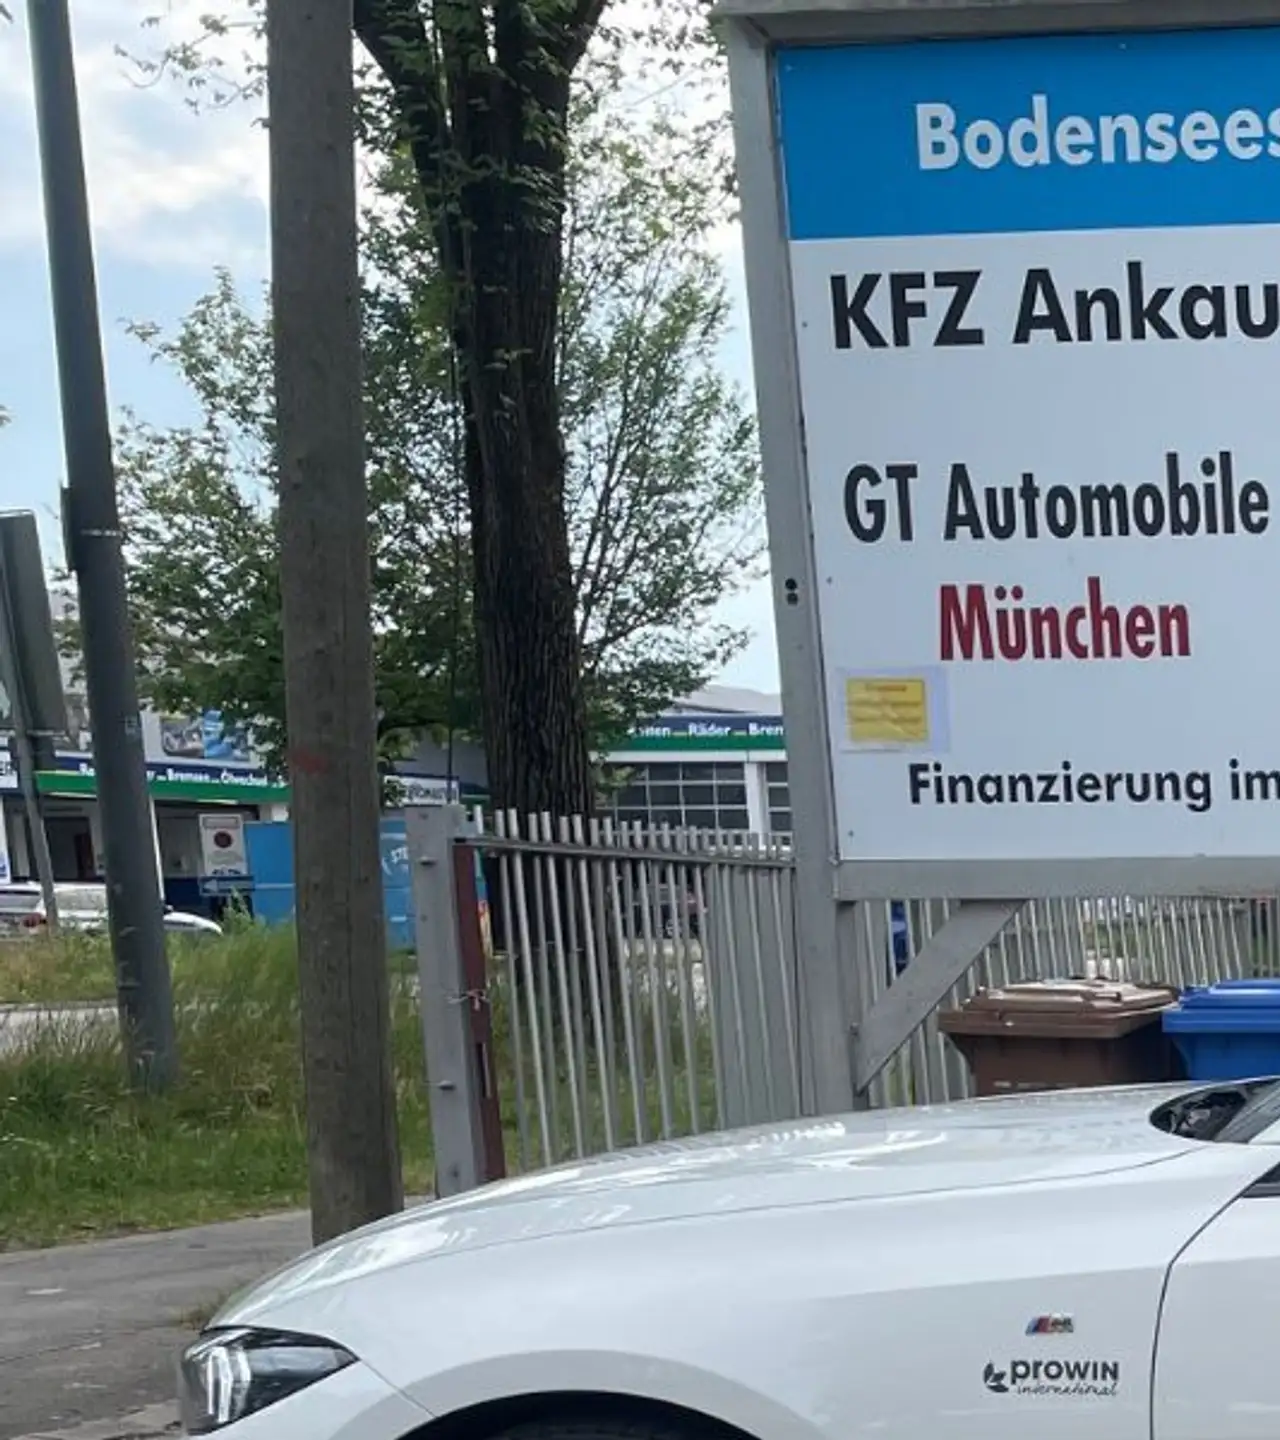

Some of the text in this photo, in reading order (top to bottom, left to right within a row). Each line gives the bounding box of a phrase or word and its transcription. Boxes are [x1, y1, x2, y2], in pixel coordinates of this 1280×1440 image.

[829, 269, 985, 350] KFZ
[843, 450, 1269, 544] GT Automobile
[938, 578, 1190, 662] München
[908, 760, 1212, 813] Finanzierung
